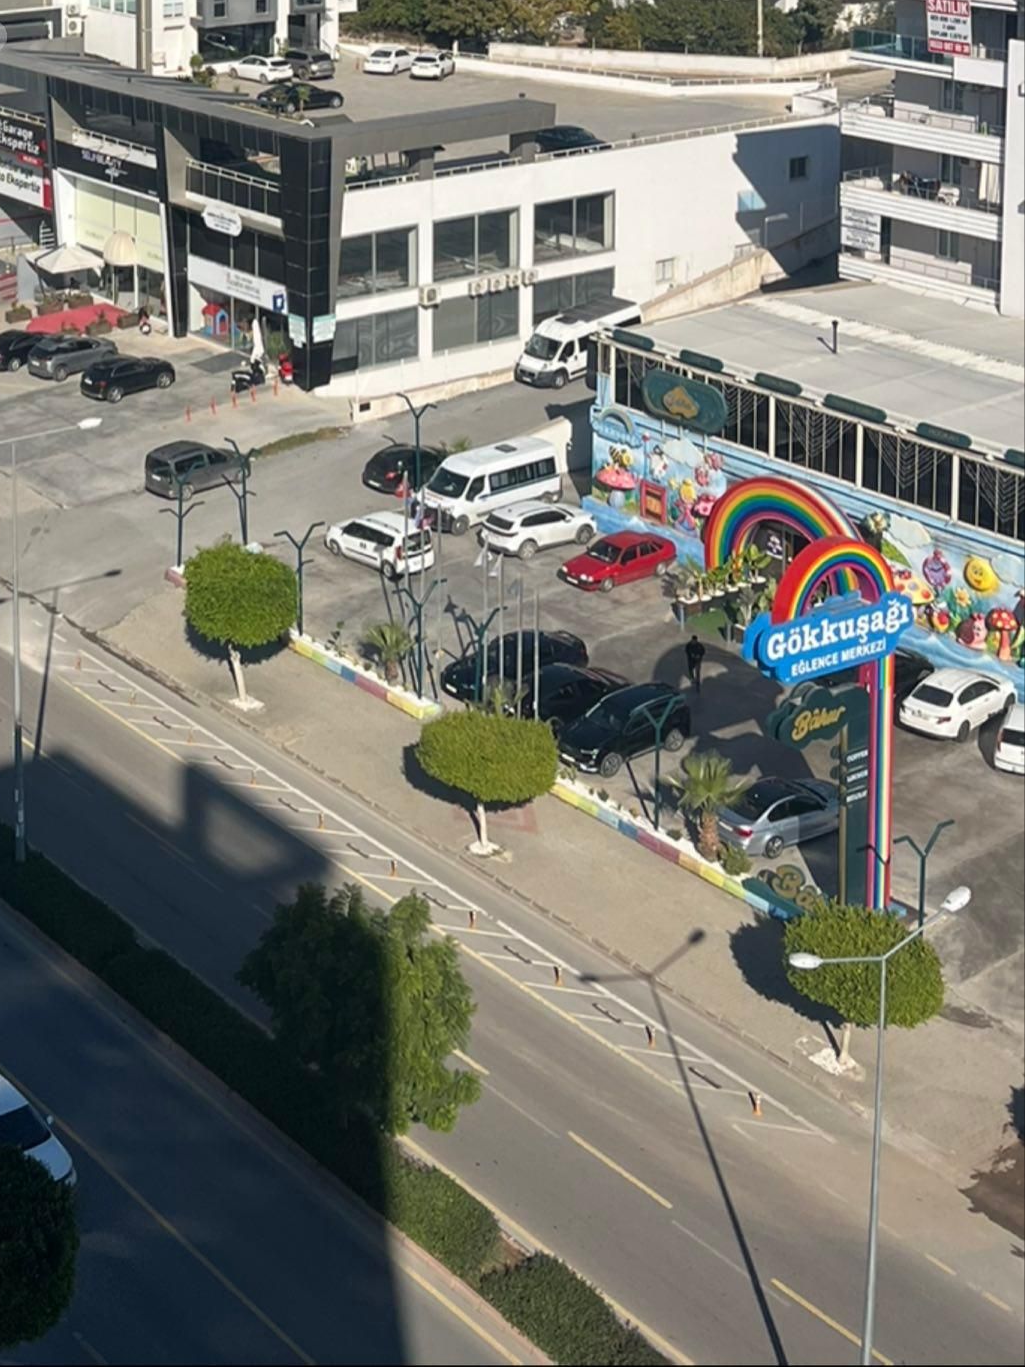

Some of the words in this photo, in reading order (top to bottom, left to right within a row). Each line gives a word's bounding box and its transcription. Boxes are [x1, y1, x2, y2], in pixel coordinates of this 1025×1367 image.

[767, 600, 910, 661] Gökkuşağı
[791, 655, 839, 678] EĞLENCE
[841, 637, 887, 662] MERKEZİ
